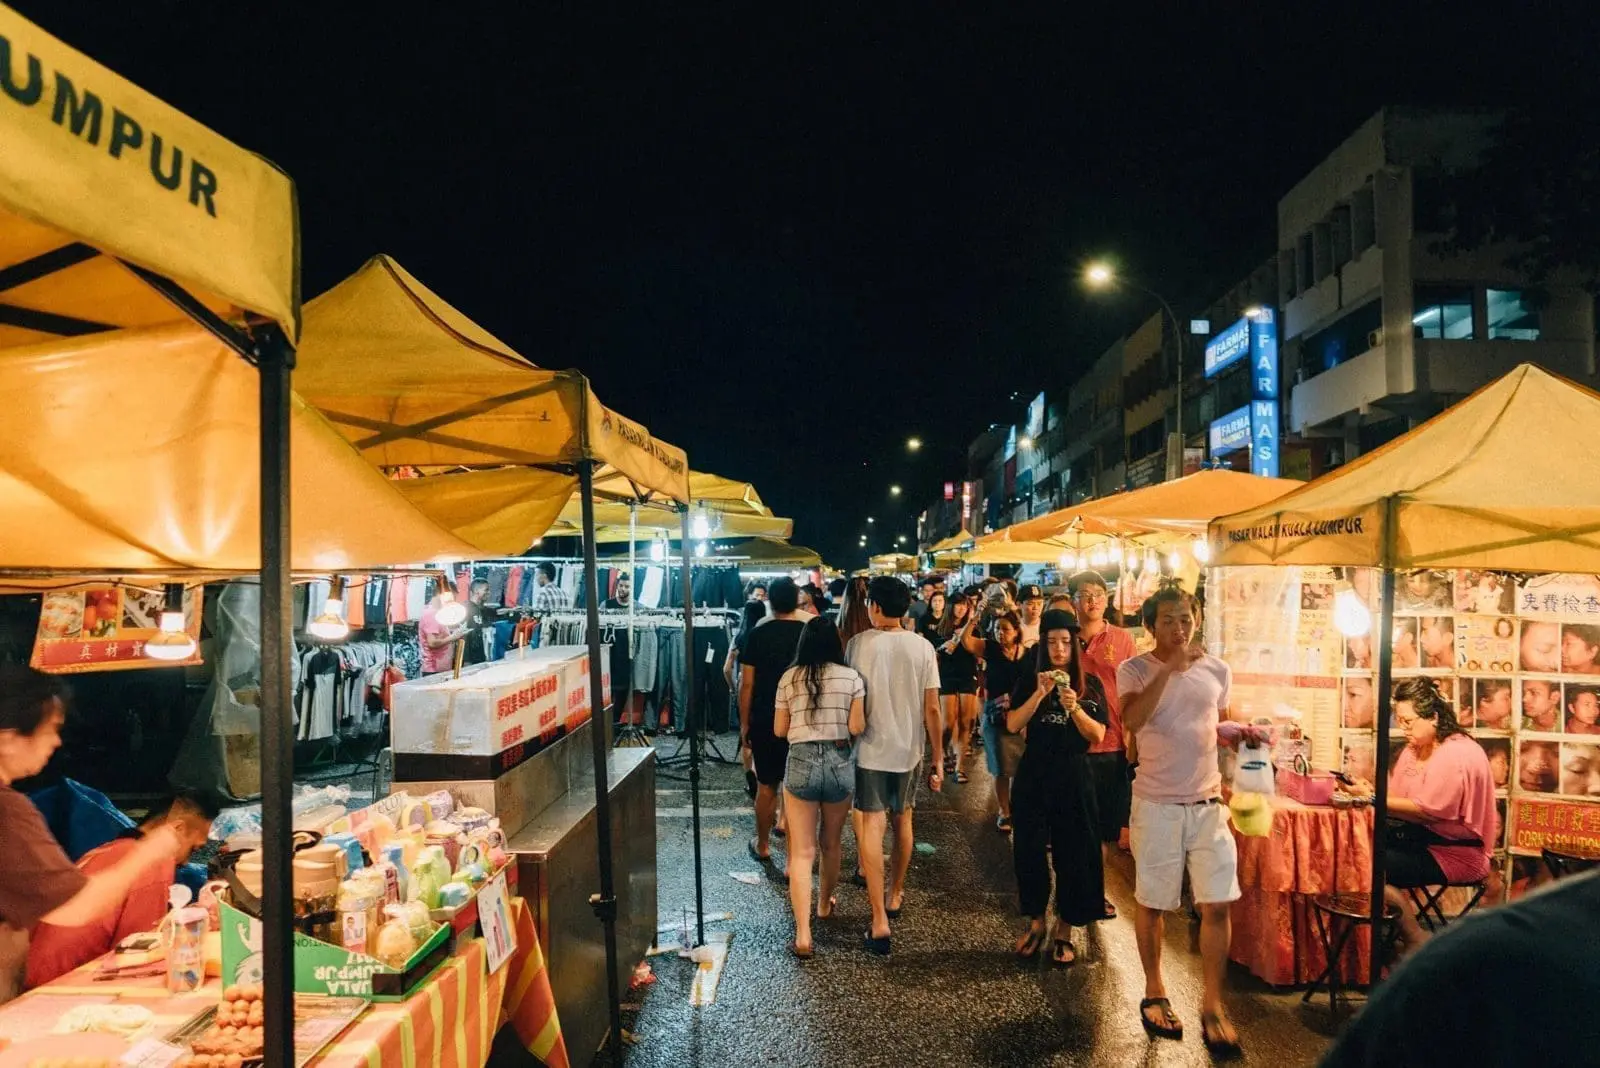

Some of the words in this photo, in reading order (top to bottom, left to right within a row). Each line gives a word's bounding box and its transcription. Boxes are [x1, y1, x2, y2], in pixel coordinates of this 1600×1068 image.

[0, 34, 217, 218] UMPUR
[1228, 528, 1250, 544] PASAR
[1281, 521, 1312, 539] KUALA
[1313, 516, 1364, 535] LUMPUR
